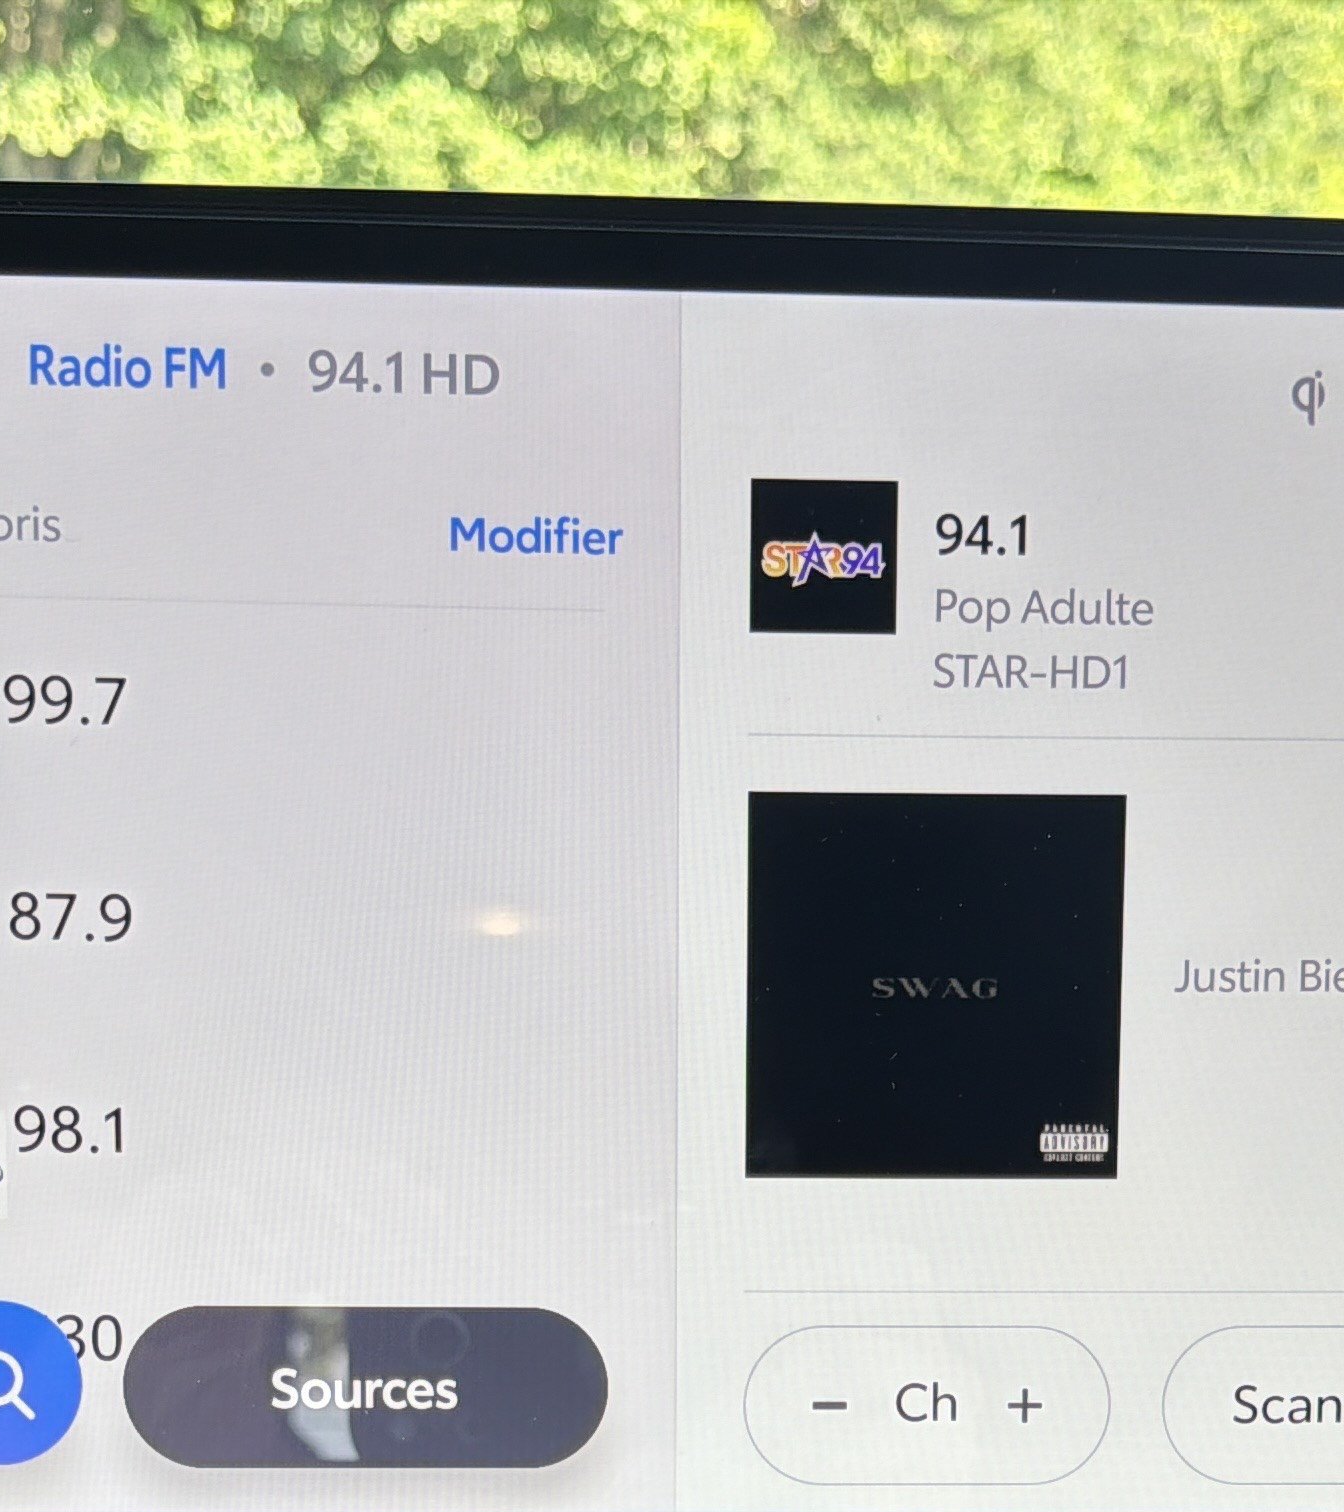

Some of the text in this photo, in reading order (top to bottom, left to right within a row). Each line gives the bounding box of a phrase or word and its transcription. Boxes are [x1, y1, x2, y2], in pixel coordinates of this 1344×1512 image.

[30, 343, 499, 395] Radio FM 94.1 HD
[451, 516, 623, 555] Modifier
[936, 514, 1026, 555] 94.1
[935, 588, 1153, 634] Pop Adulte
[934, 653, 1126, 689] STAR-HD1
[4, 675, 126, 725] 99.7
[10, 892, 131, 942] 87.9
[873, 978, 997, 998] SWAG
[1174, 958, 1285, 992] Justin
[14, 1105, 121, 1153] 98.1
[271, 1367, 458, 1411] Sources
[896, 1382, 956, 1422] Ch
[1234, 1385, 1341, 1424] Scan
